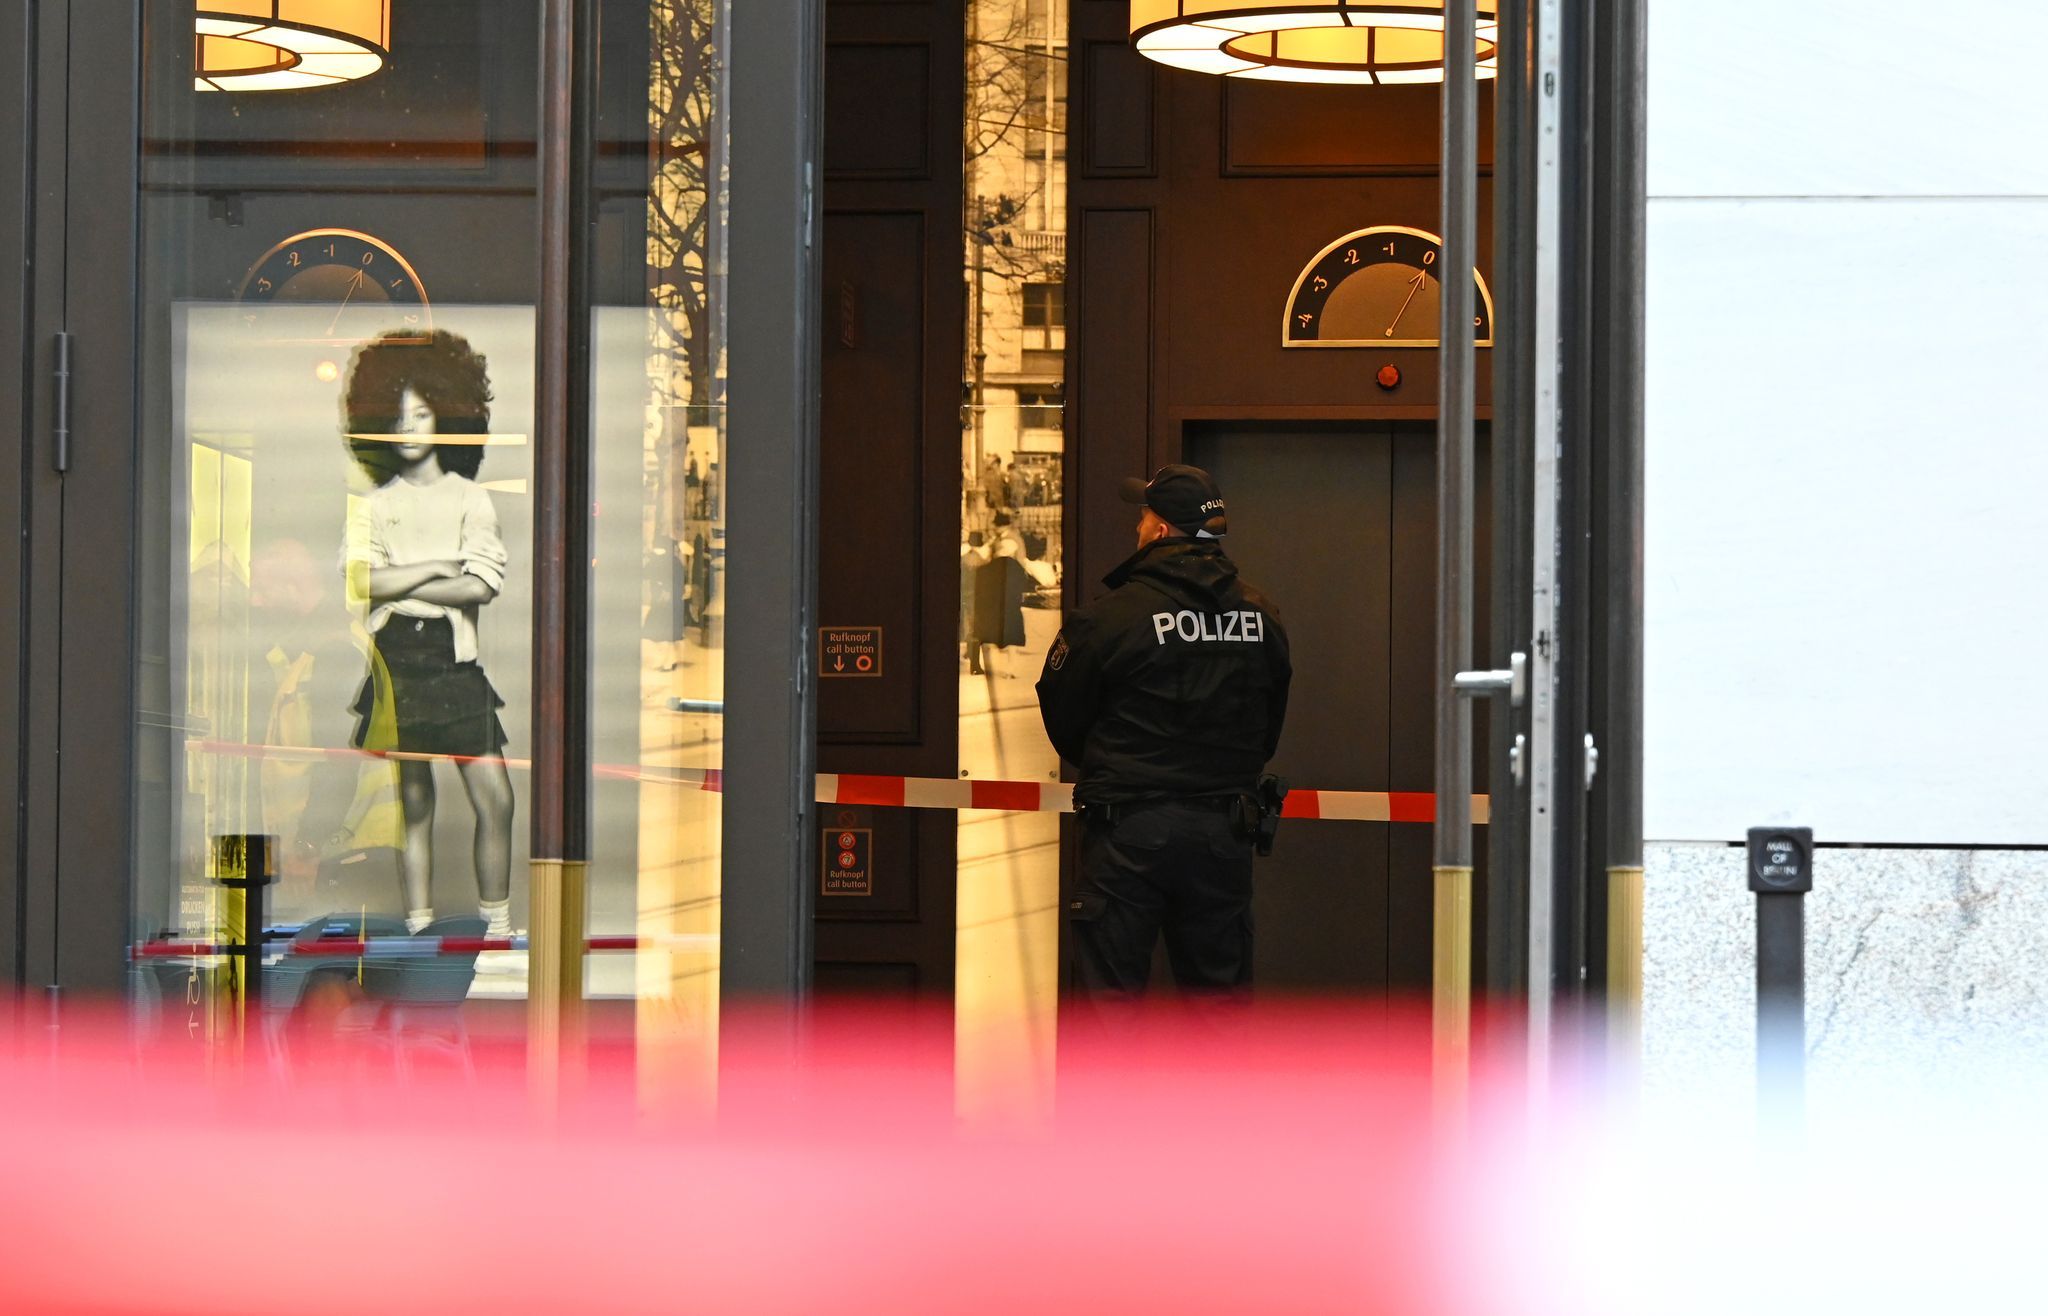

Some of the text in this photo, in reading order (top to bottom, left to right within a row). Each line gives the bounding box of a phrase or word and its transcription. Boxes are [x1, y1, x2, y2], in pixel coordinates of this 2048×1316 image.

[257, 277, 272, 293] -3
[286, 251, 301, 267] -2
[323, 243, 335, 257] -1
[362, 251, 373, 265] 0
[404, 314, 418, 324] 2
[1298, 242, 1435, 328] -4 -3 -2 -1 0
[1152, 609, 1264, 645] POLIZEI
[830, 631, 872, 644] Rufknopf
[826, 644, 874, 654] call button
[1766, 841, 1793, 852] MALL
[1771, 853, 1787, 864] OF
[830, 870, 865, 880] Rufknopf
[827, 880, 867, 888] call button
